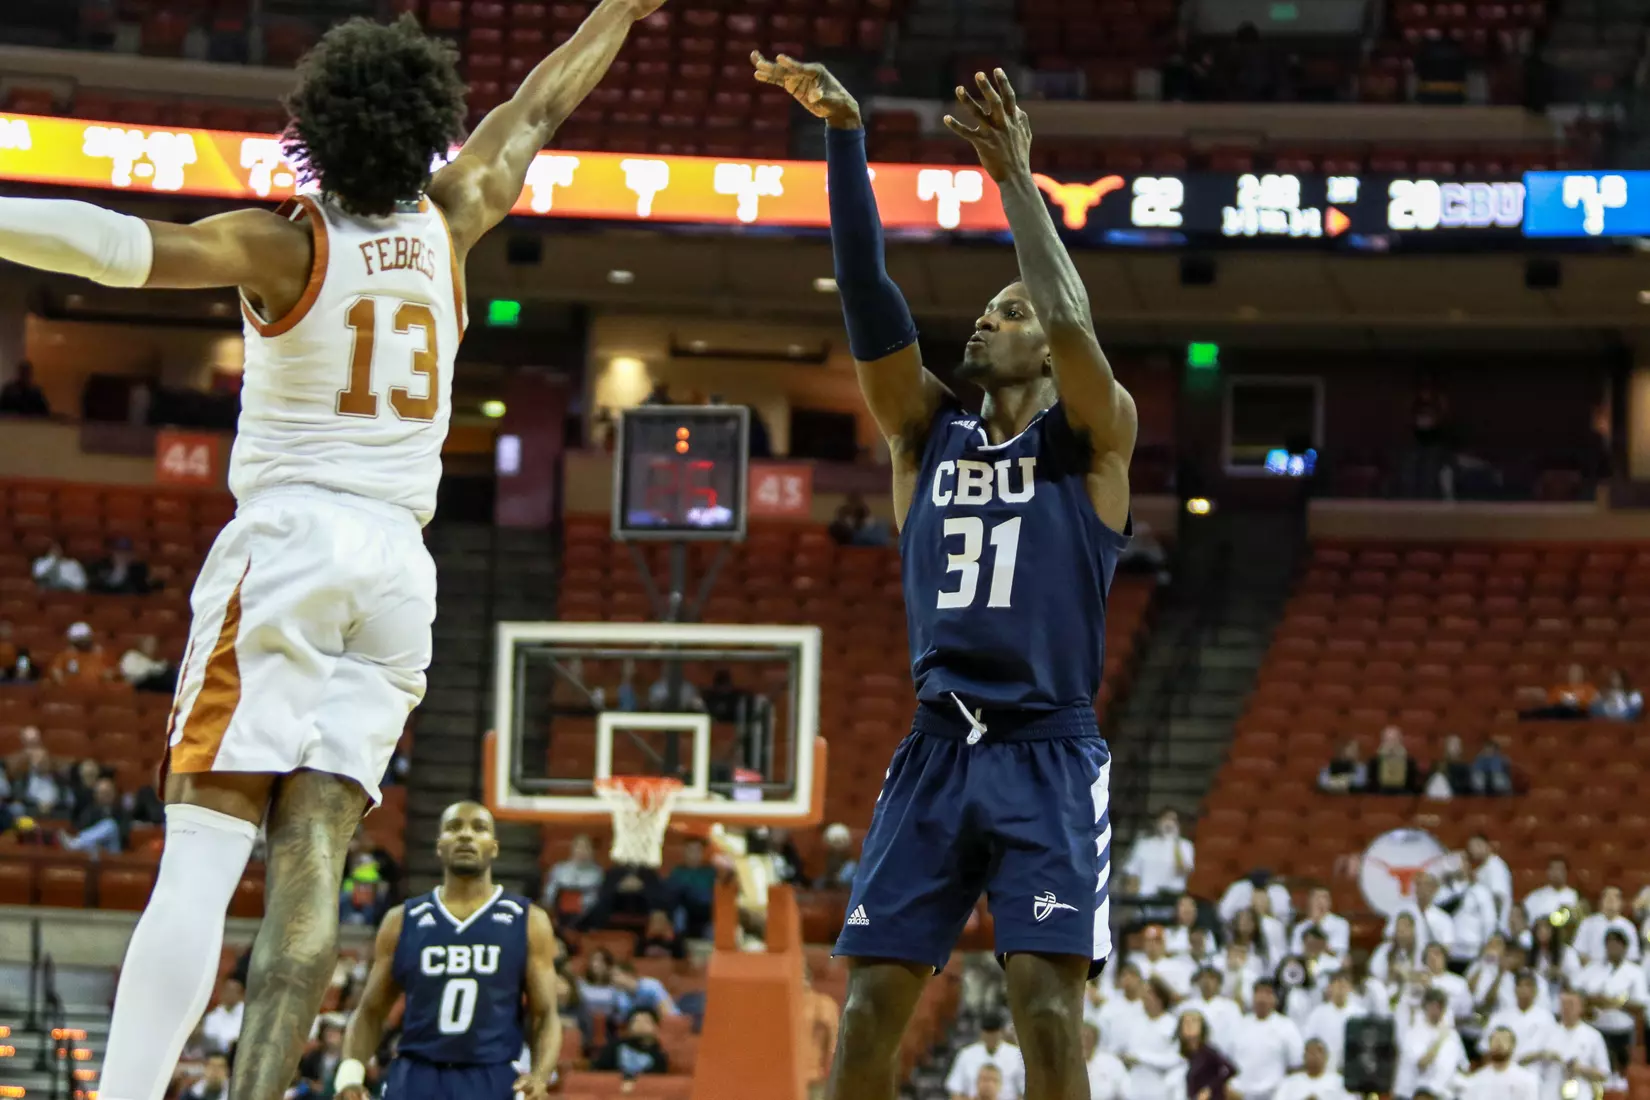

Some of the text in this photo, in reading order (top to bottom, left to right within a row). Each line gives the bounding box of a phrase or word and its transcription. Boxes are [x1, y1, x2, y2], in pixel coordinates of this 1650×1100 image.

[1440, 183, 1526, 227] CBU
[335, 294, 440, 423] 13
[164, 443, 209, 478] 44
[932, 457, 1036, 506] CBU
[757, 474, 802, 505] 43
[936, 516, 1022, 609] 31
[847, 917, 870, 926] adidas
[420, 945, 500, 976] CBU
[438, 978, 478, 1034] 0
